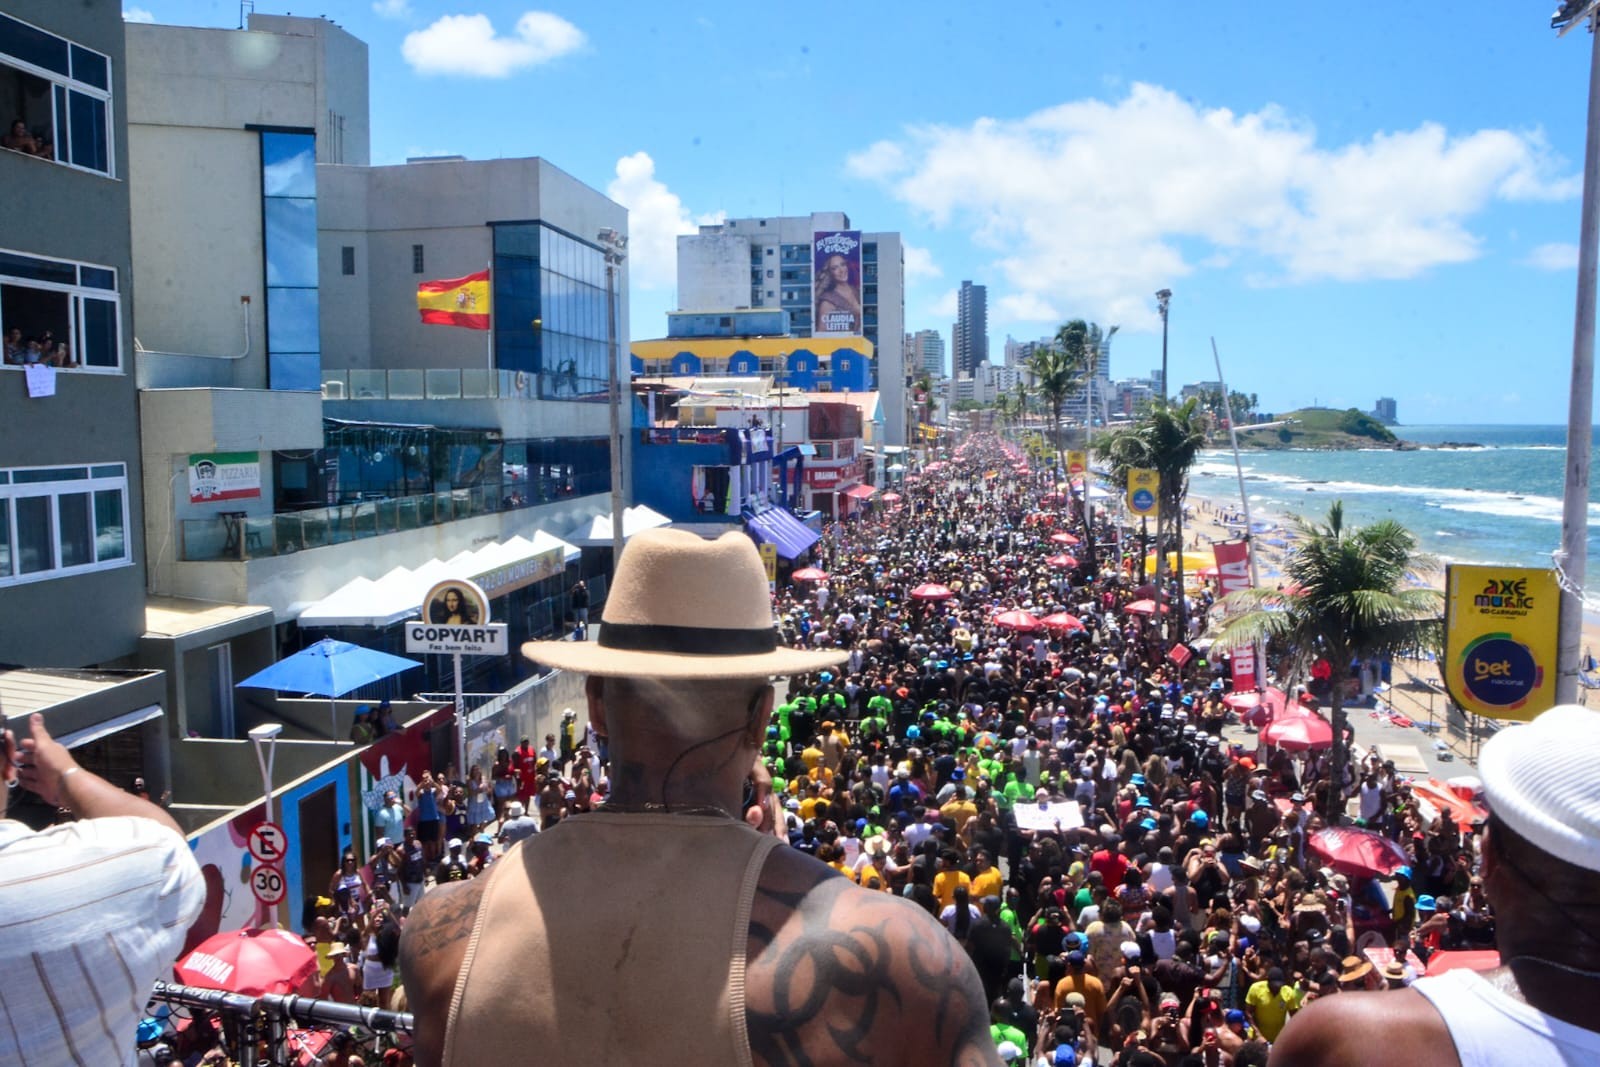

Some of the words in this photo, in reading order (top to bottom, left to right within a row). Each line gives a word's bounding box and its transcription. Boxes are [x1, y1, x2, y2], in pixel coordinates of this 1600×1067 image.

[821, 314, 855, 323] CLAUDIA
[412, 628, 498, 643] COPYART
[464, 644, 482, 652] feito
[1475, 658, 1511, 677] bet
[260, 831, 275, 855] E
[256, 872, 281, 892] 30
